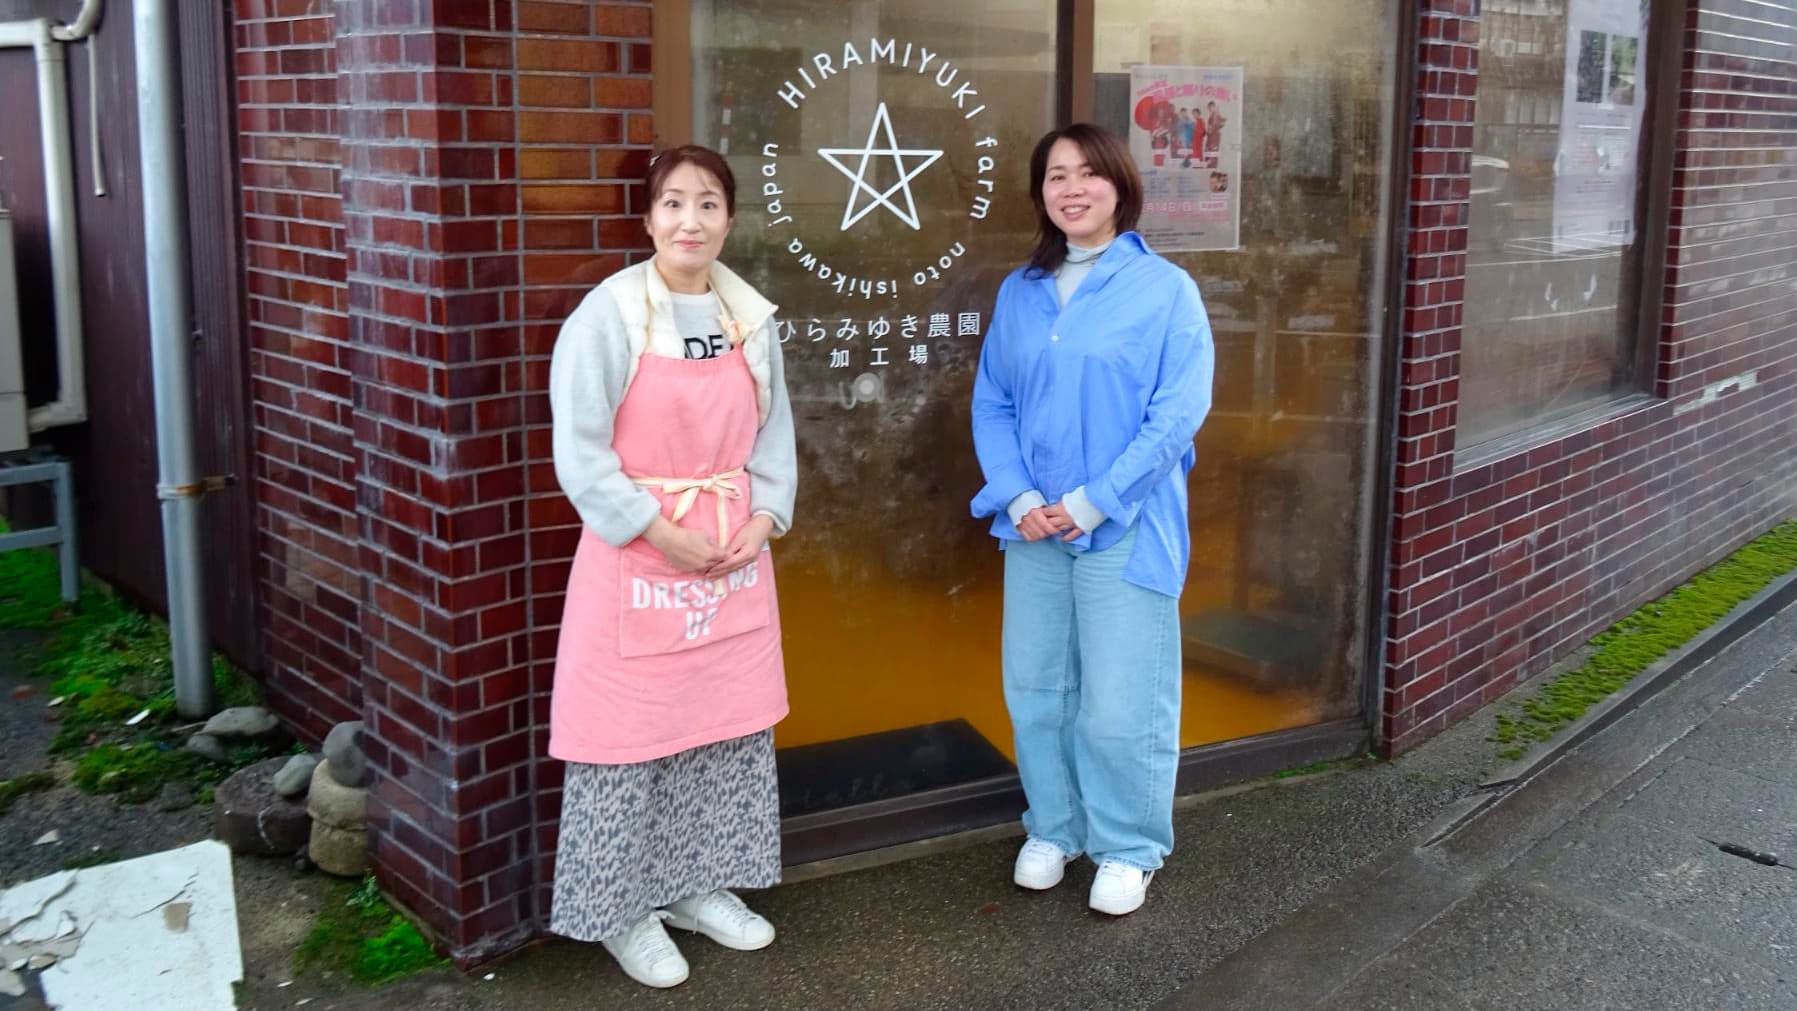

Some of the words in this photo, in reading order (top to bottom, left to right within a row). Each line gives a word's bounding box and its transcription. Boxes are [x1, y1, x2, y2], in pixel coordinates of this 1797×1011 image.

[777, 37, 986, 120] HIRAMIYUKI
[969, 136, 998, 220] farm
[762, 142, 793, 228] japan
[787, 237, 898, 299] ishikawa
[913, 241, 966, 286] noto
[776, 312, 981, 344] ひらみゆき農園
[829, 344, 929, 369] 加工場
[632, 561, 759, 609] DRESSNG
